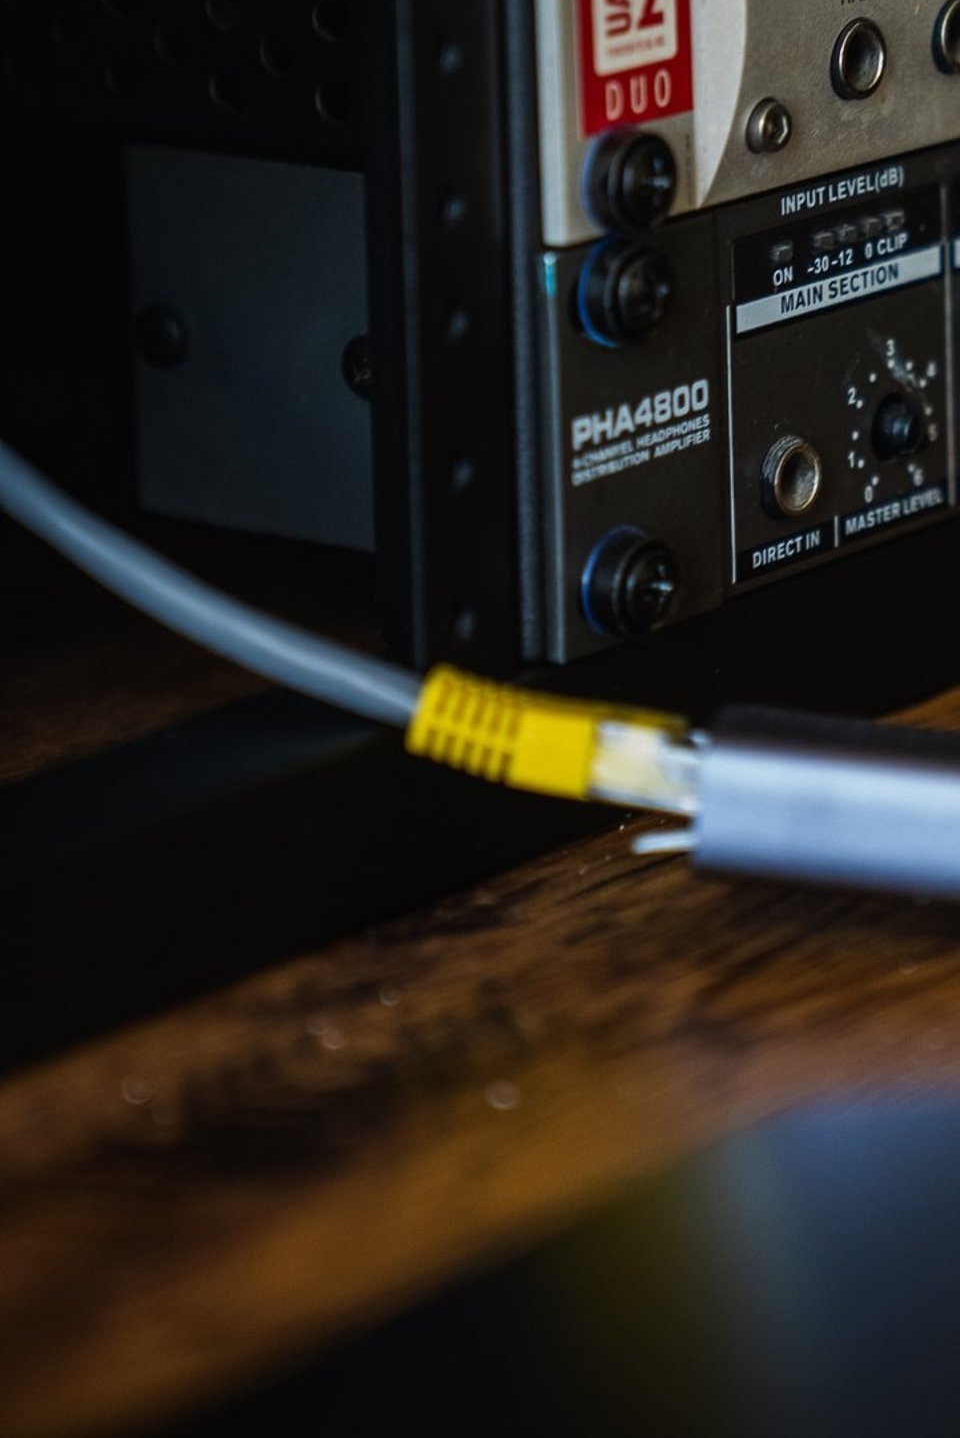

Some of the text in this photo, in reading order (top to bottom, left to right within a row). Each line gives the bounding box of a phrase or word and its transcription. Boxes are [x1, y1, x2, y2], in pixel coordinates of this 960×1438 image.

[604, 67, 673, 123] DUO
[781, 165, 905, 216] INPUT LEVEL(dB)
[773, 266, 794, 286] ON
[876, 232, 908, 255] CLIP
[781, 262, 900, 314] MAIN SECTION
[886, 338, 896, 356] 3
[571, 377, 710, 452] PHA4800
[847, 387, 857, 406] 2
[635, 413, 711, 449] HEADPHONES
[653, 428, 712, 459] AMPLIFIER
[848, 451, 855, 469] 1
[844, 486, 944, 537] MASTER LEVEL
[864, 484, 874, 504] 0
[752, 529, 821, 570] DIRECT IN
